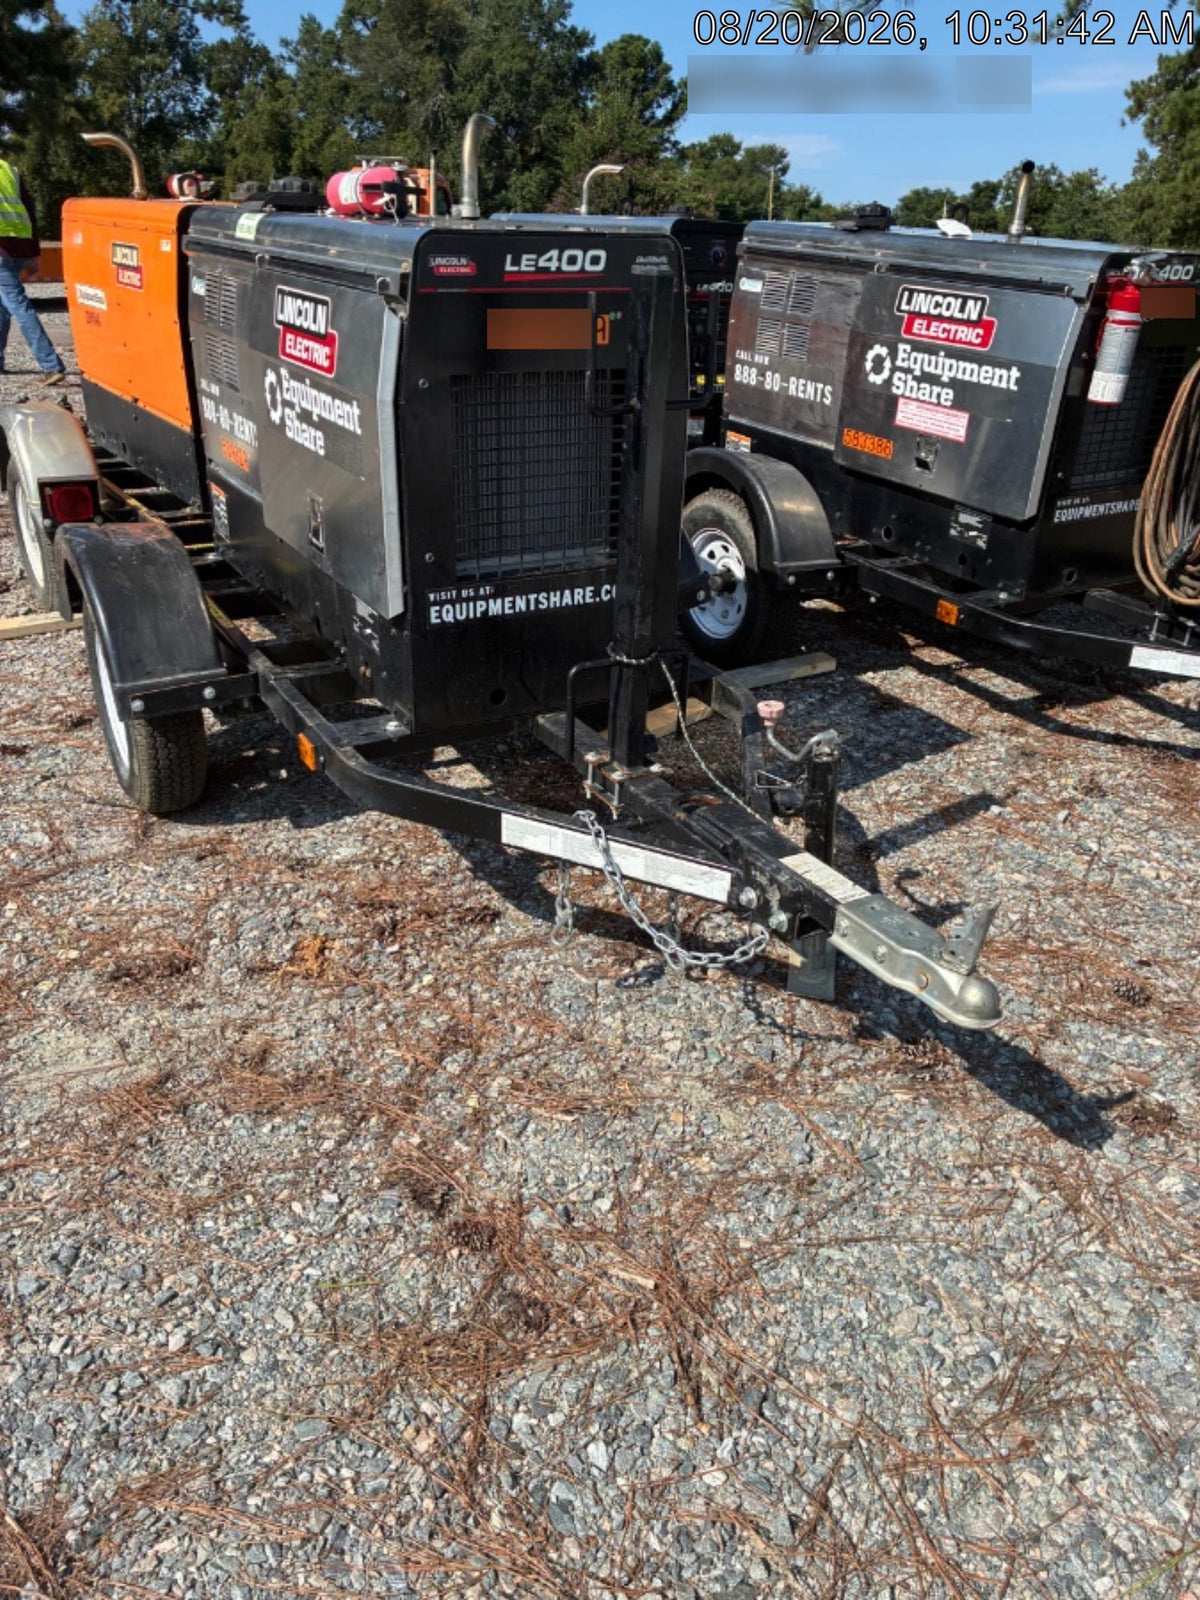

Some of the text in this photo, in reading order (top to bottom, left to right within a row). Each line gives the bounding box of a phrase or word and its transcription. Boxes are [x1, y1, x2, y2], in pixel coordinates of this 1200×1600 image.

[430, 256, 467, 266] LINCOLN
[504, 249, 607, 272] LE400
[276, 293, 328, 335] LINCOLN
[900, 290, 982, 321] LINCOLN
[912, 318, 984, 344] ELECTRIC
[285, 332, 331, 368] ELECTRIC
[895, 342, 1022, 392] Equipment
[279, 367, 362, 436] Equipment
[733, 363, 833, 406] 888-80-RENTS
[891, 370, 954, 407] Share
[284, 407, 326, 457] Share
[428, 588, 457, 602] VISIT
[461, 586, 475, 599] US
